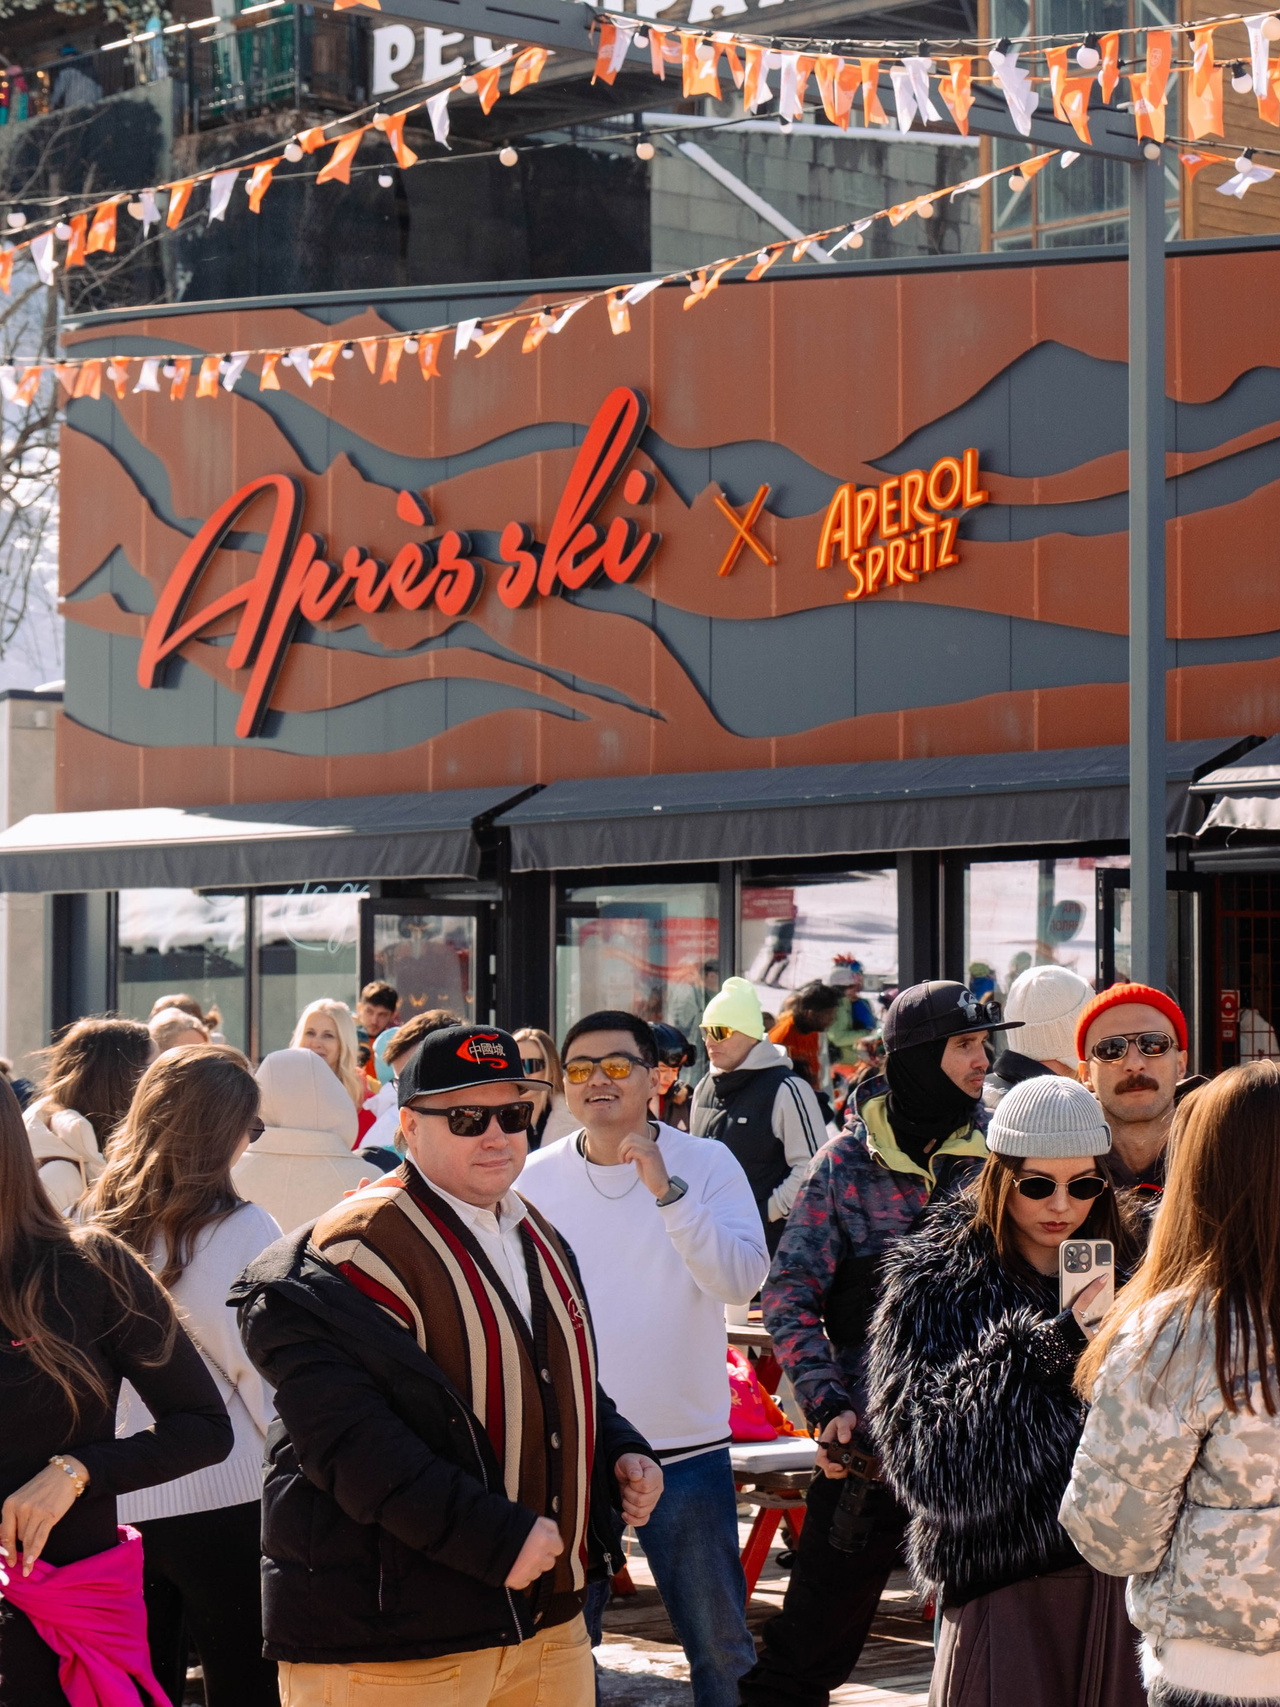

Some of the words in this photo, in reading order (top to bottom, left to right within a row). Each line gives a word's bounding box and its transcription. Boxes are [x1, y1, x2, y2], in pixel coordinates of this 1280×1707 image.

[138, 473, 484, 739] Après
[497, 386, 663, 609] ski
[816, 448, 989, 569] APEROL
[469, 1039, 506, 1062] 中國城
